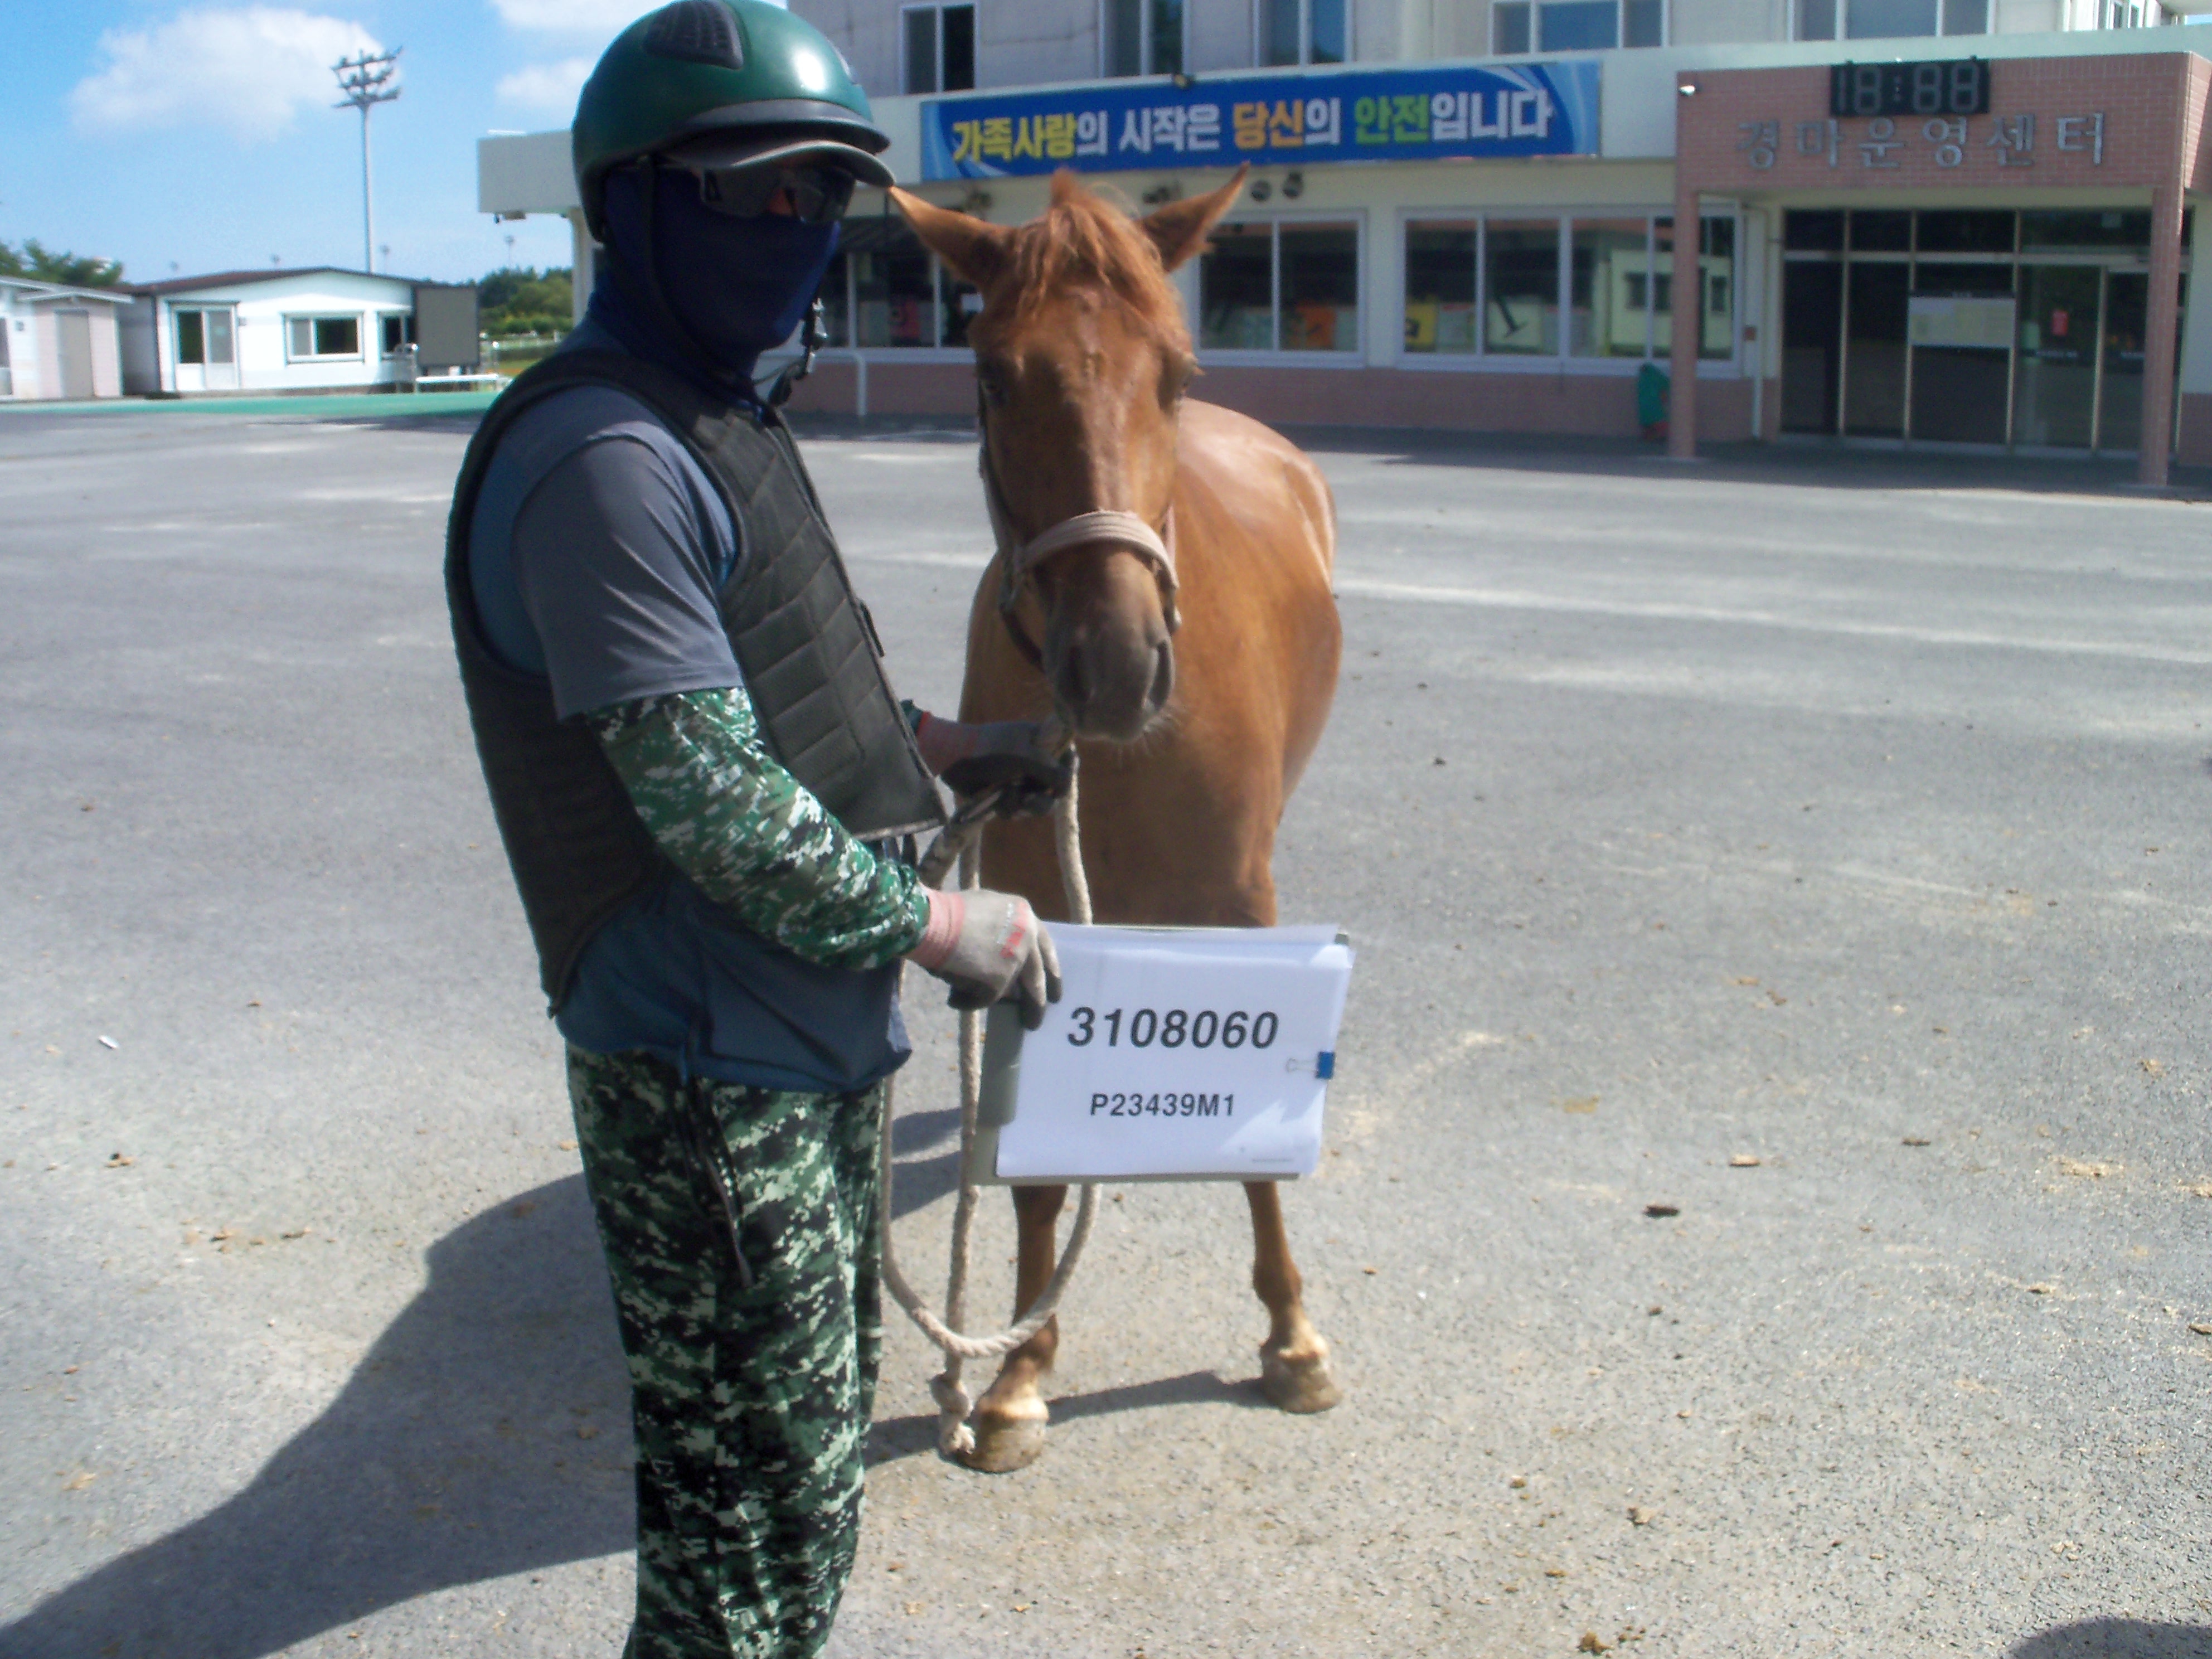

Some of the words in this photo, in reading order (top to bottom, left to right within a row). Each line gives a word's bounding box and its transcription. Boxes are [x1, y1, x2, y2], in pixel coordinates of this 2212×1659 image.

[952, 111, 1108, 162] 가족사랑의
[1119, 104, 1221, 153] 시작은
[1233, 97, 1340, 149] 당신의
[1354, 88, 1554, 144] 안전입니다
[1736, 113, 2104, 169] 경마운영센터
[1068, 1007, 1280, 1049] 3108060
[1090, 1093, 1235, 1117] P23439M1
